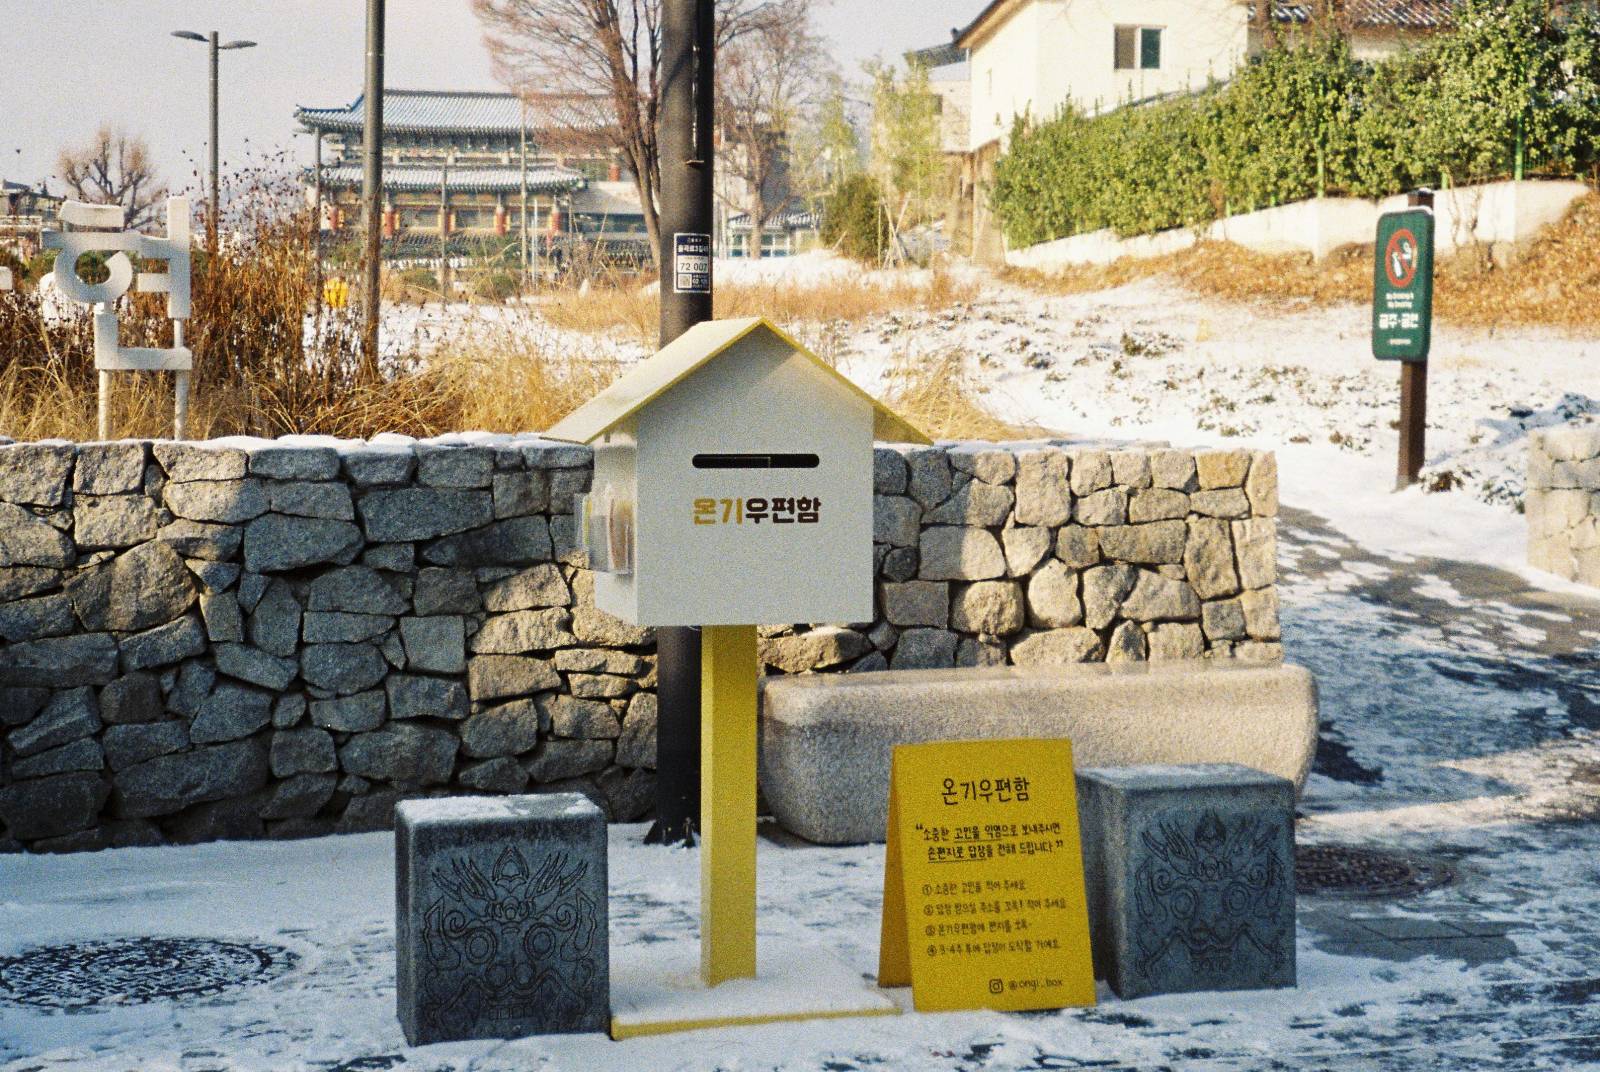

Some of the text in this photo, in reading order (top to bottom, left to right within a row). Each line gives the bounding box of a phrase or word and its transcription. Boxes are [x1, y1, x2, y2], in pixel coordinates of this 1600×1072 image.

[0, 196, 192, 370] 현
[693, 496, 822, 525] 온기우편함
[941, 777, 1030, 805] 온기우편함
[954, 825, 980, 840] 고민을
[984, 824, 1018, 839] 익명으로
[1021, 822, 1061, 836] 보내주시면
[927, 846, 964, 861] 손편지로
[968, 844, 993, 858] 답장을
